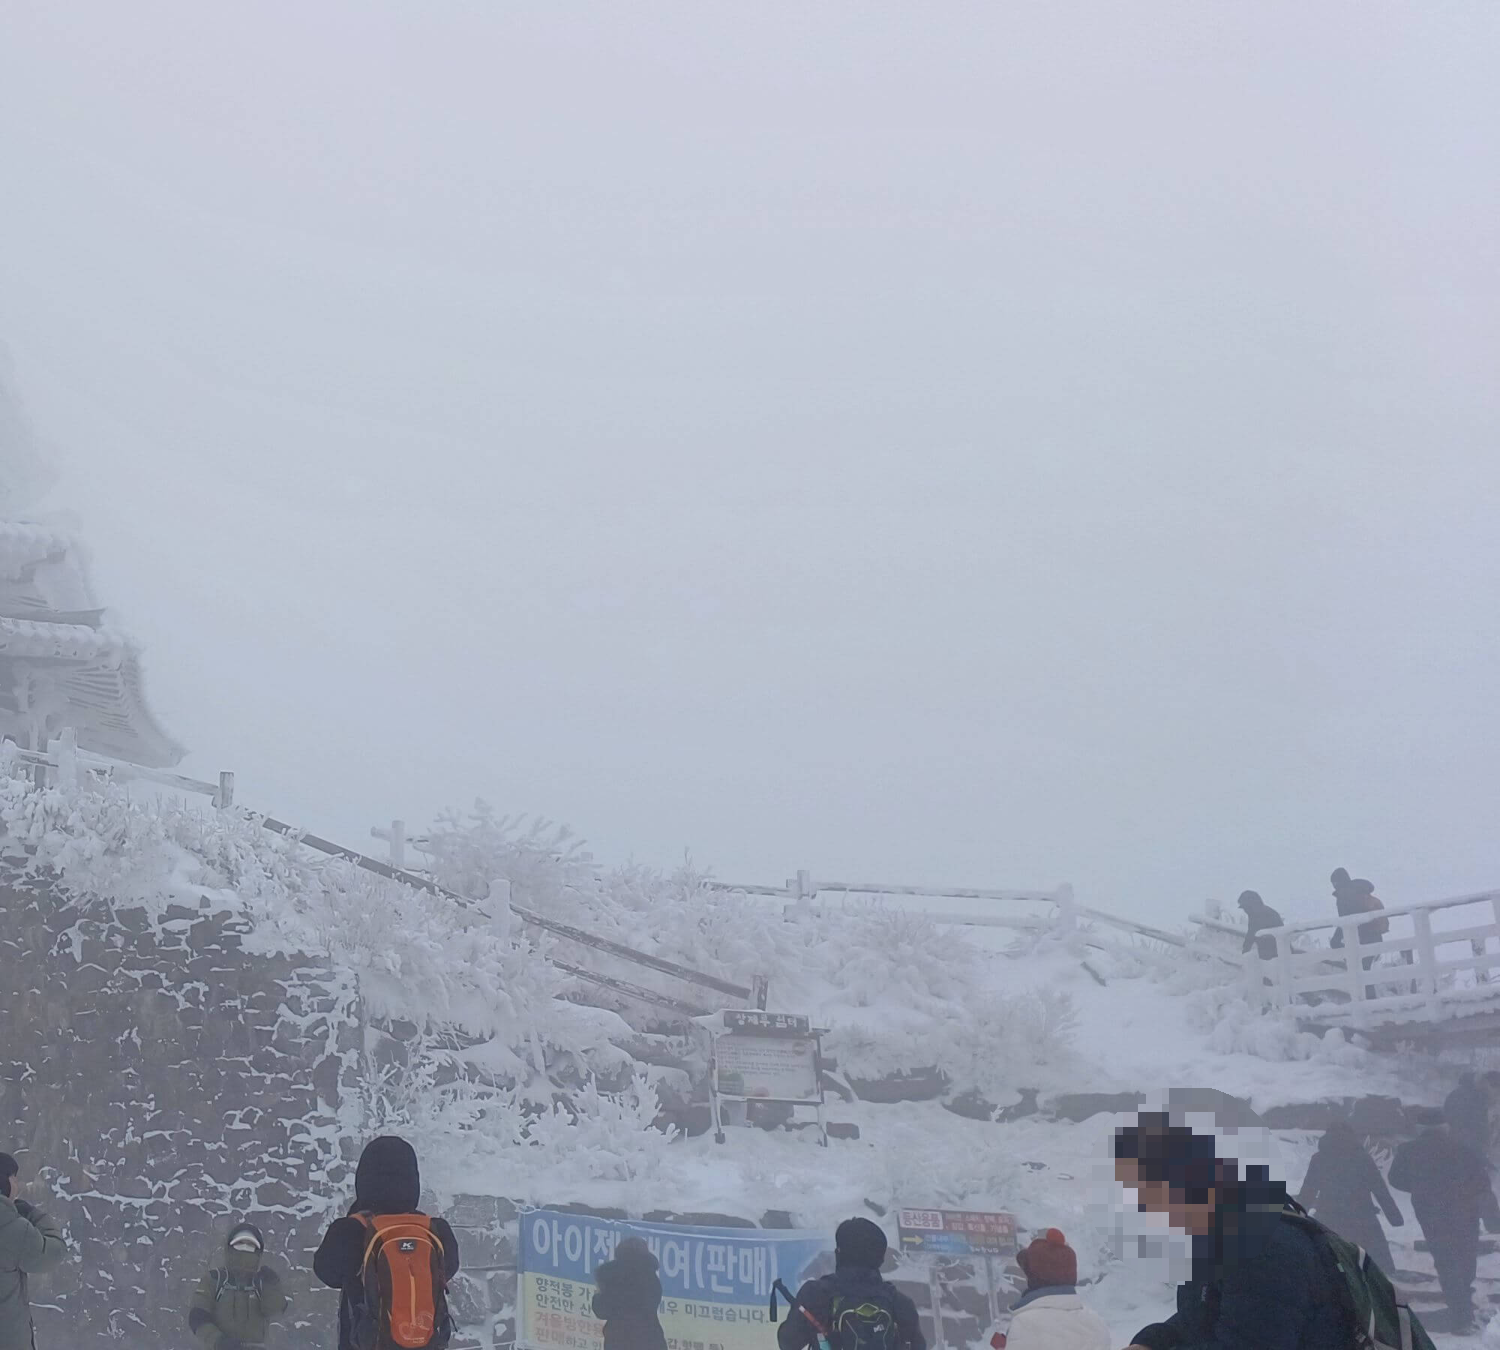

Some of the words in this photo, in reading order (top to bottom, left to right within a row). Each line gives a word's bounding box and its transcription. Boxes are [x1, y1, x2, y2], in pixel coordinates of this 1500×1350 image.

[903, 1211, 940, 1228] 등산용품
[532, 1218, 621, 1275] 아이젠
[535, 1276, 574, 1299] 향적봉
[579, 1303, 593, 1319] 산
[684, 1303, 769, 1324] 미끄럽습니다.
[534, 1310, 603, 1339] 겨울방한용
[534, 1326, 588, 1348] 판매하고
